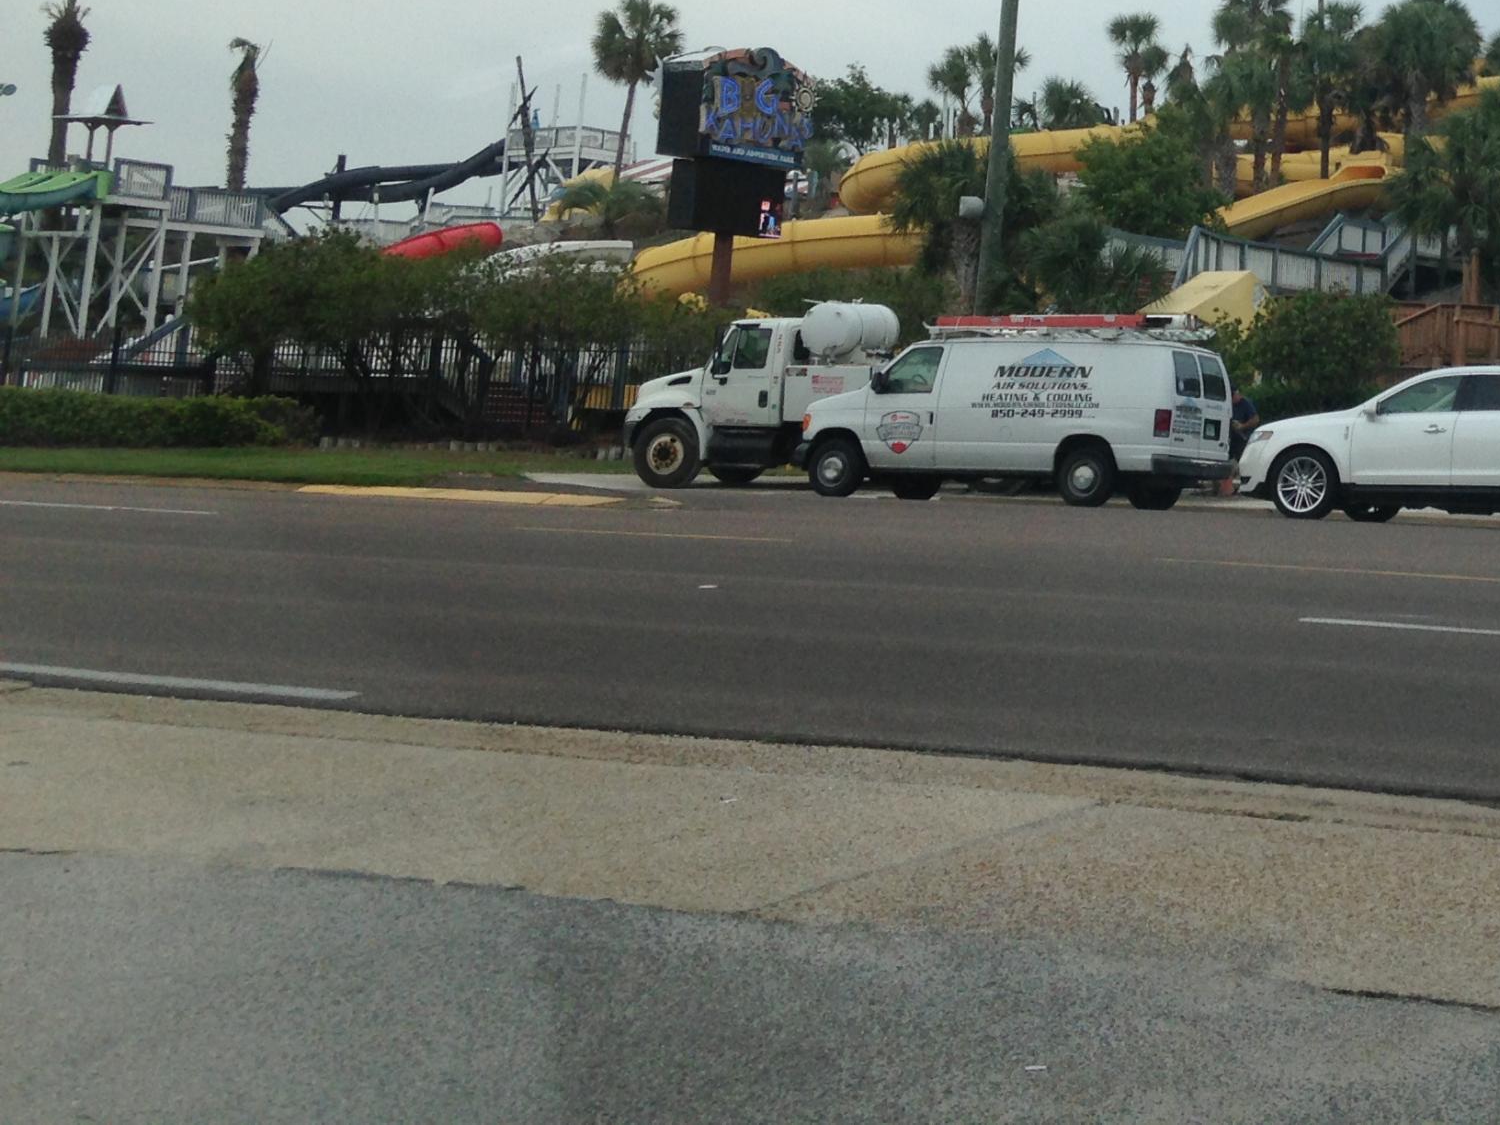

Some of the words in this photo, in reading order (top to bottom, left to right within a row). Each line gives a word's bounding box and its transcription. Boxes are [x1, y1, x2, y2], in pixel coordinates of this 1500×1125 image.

[994, 365, 1093, 378] MODERN
[992, 381, 1015, 390] AIR
[1018, 381, 1088, 390] SOLUTIONS
[982, 393, 1028, 402] HEATING
[1033, 393, 1040, 402] &
[1046, 393, 1093, 402] COOLING
[991, 409, 1083, 419] 850-249-2999
